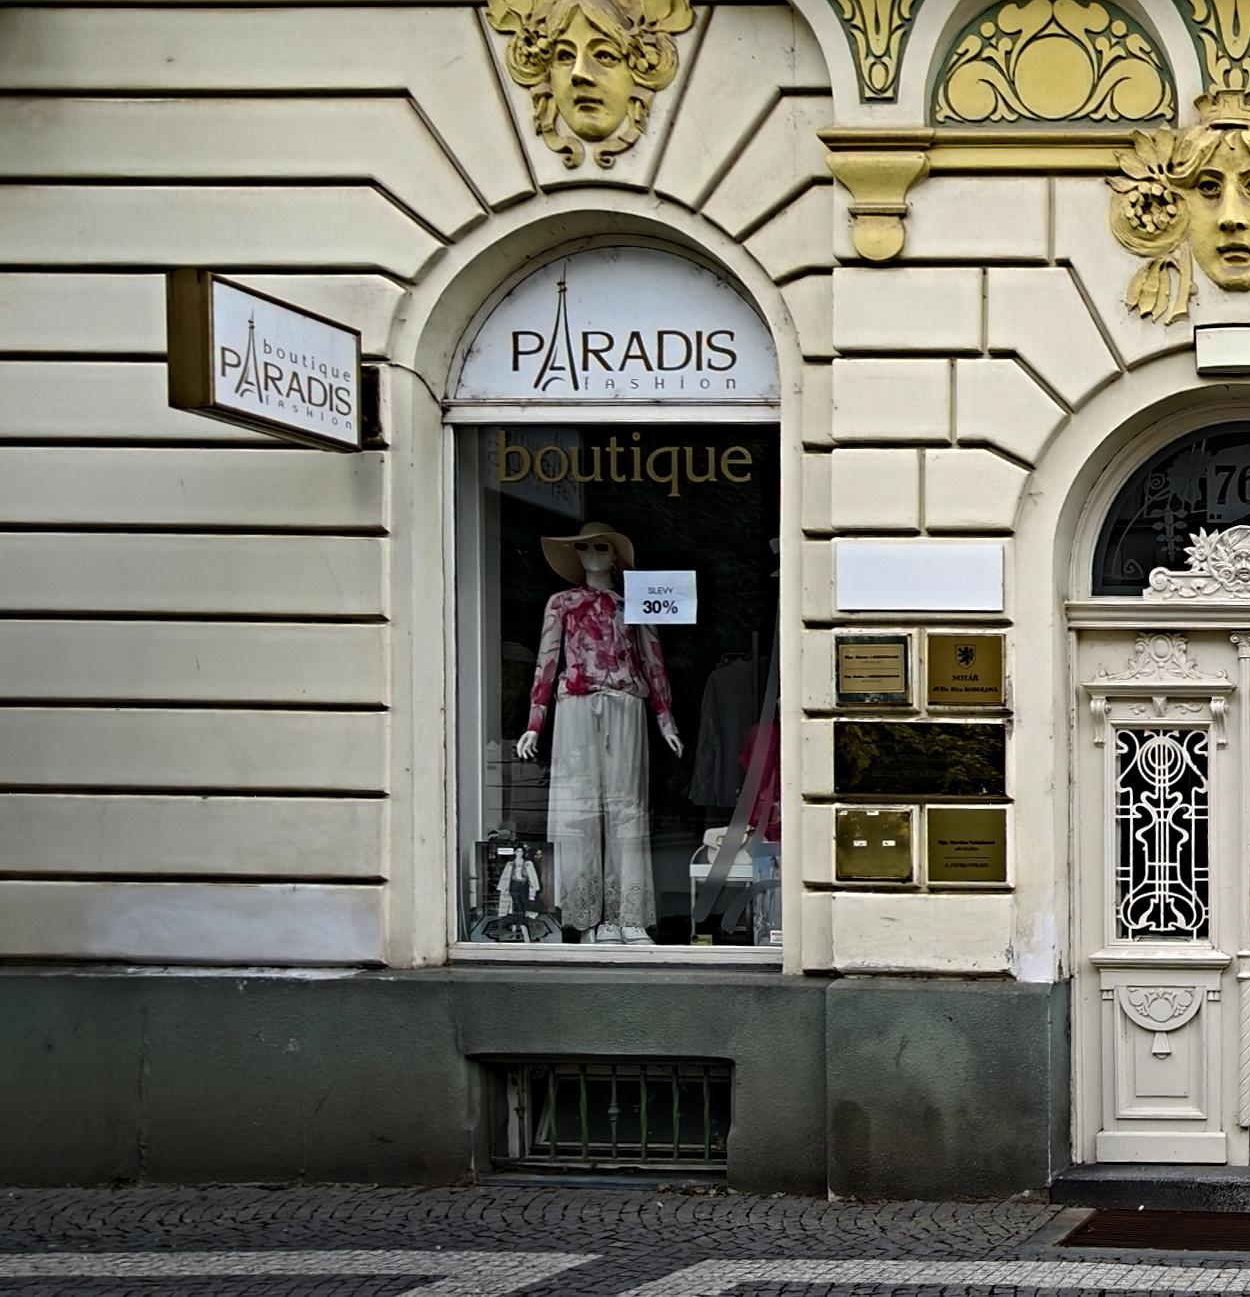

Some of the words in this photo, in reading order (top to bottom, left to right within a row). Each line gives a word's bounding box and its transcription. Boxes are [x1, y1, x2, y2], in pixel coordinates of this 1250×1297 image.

[263, 338, 351, 383] boutique
[511, 279, 738, 392] PARADIS
[220, 317, 353, 417] PARADIS
[496, 430, 753, 498] boutique
[642, 600, 679, 615] 30%
[647, 586, 674, 595] SLEVY
